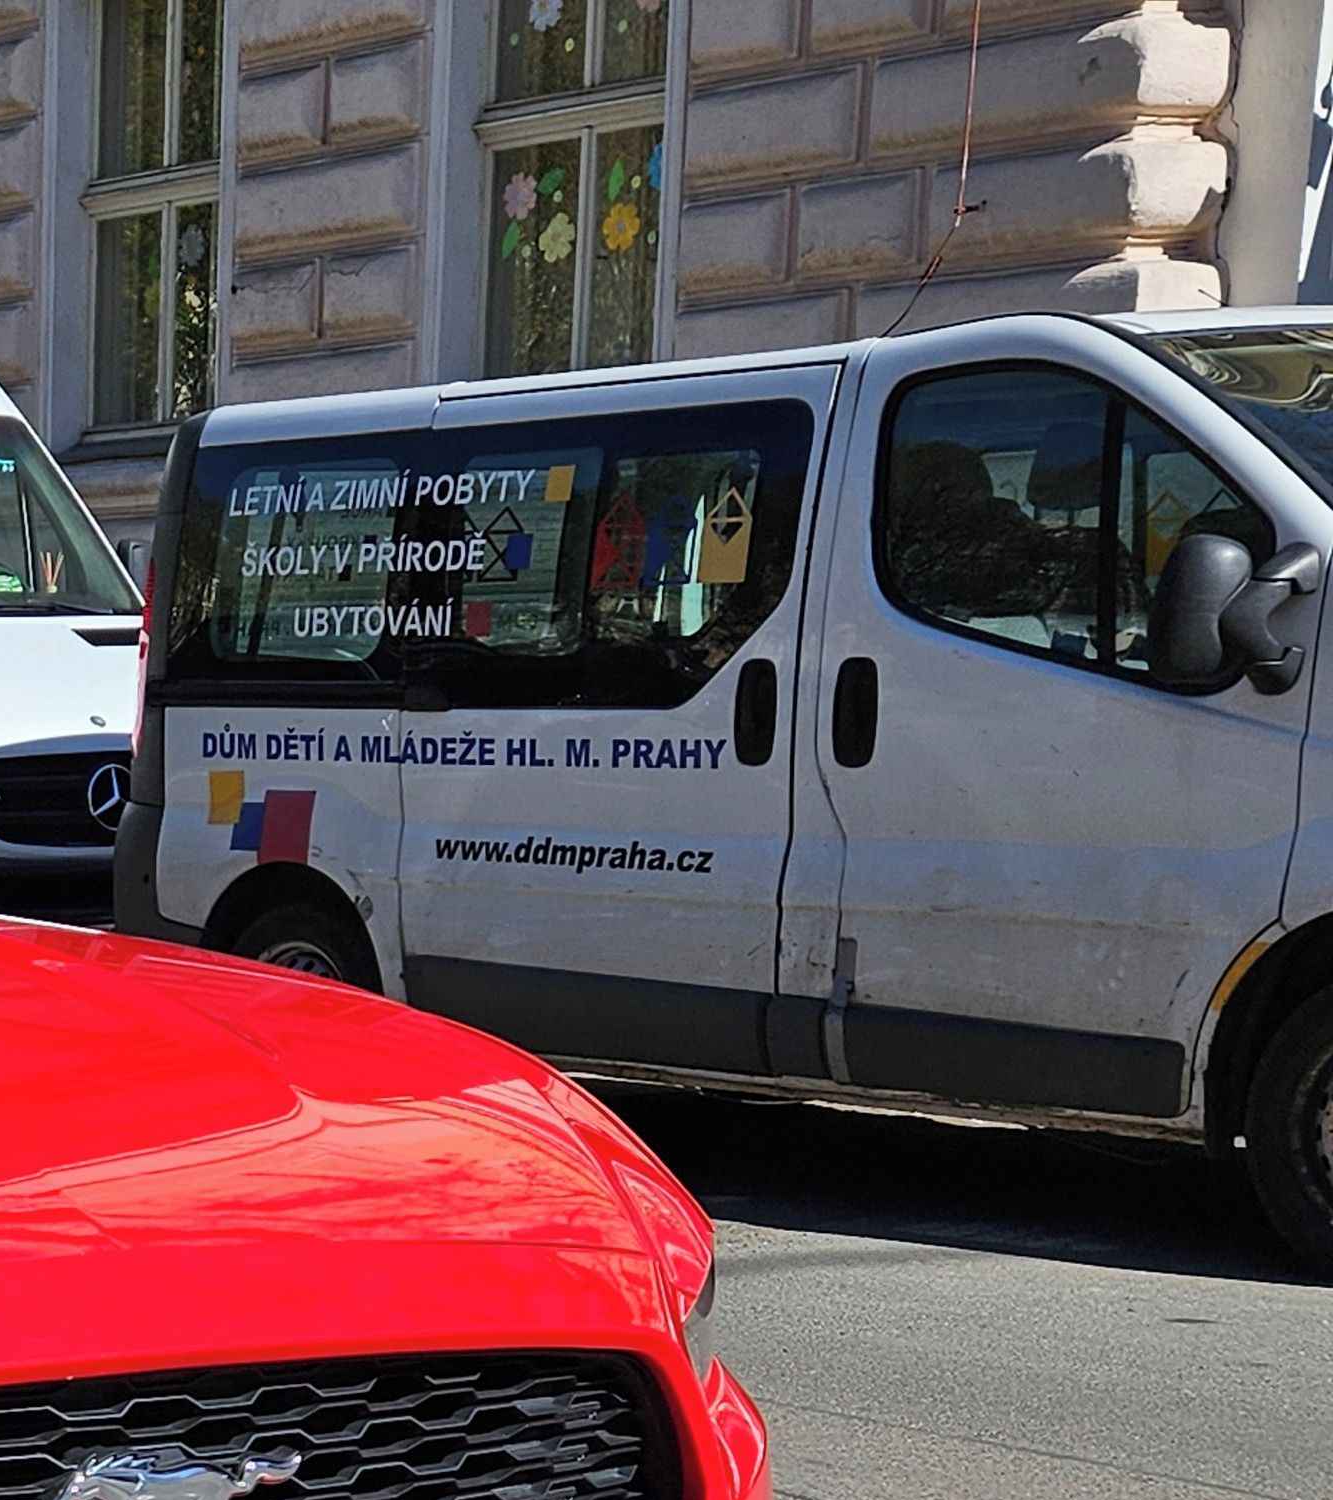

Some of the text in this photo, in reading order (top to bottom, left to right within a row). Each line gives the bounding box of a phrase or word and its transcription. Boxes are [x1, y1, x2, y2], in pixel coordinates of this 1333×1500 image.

[229, 469, 536, 517] LETNÍ A ZIMNÍ POBYTY
[241, 541, 328, 577] ŠKOLY
[335, 543, 352, 574] V
[357, 531, 486, 574] PŘÍRODĚ
[294, 597, 454, 638] UBYTOVÁNÍ
[202, 723, 727, 770] DŮM DĚTÍ A MLÁDEŽE HL. M. PRAHY
[435, 836, 714, 874] www.ddmpraha.cz
